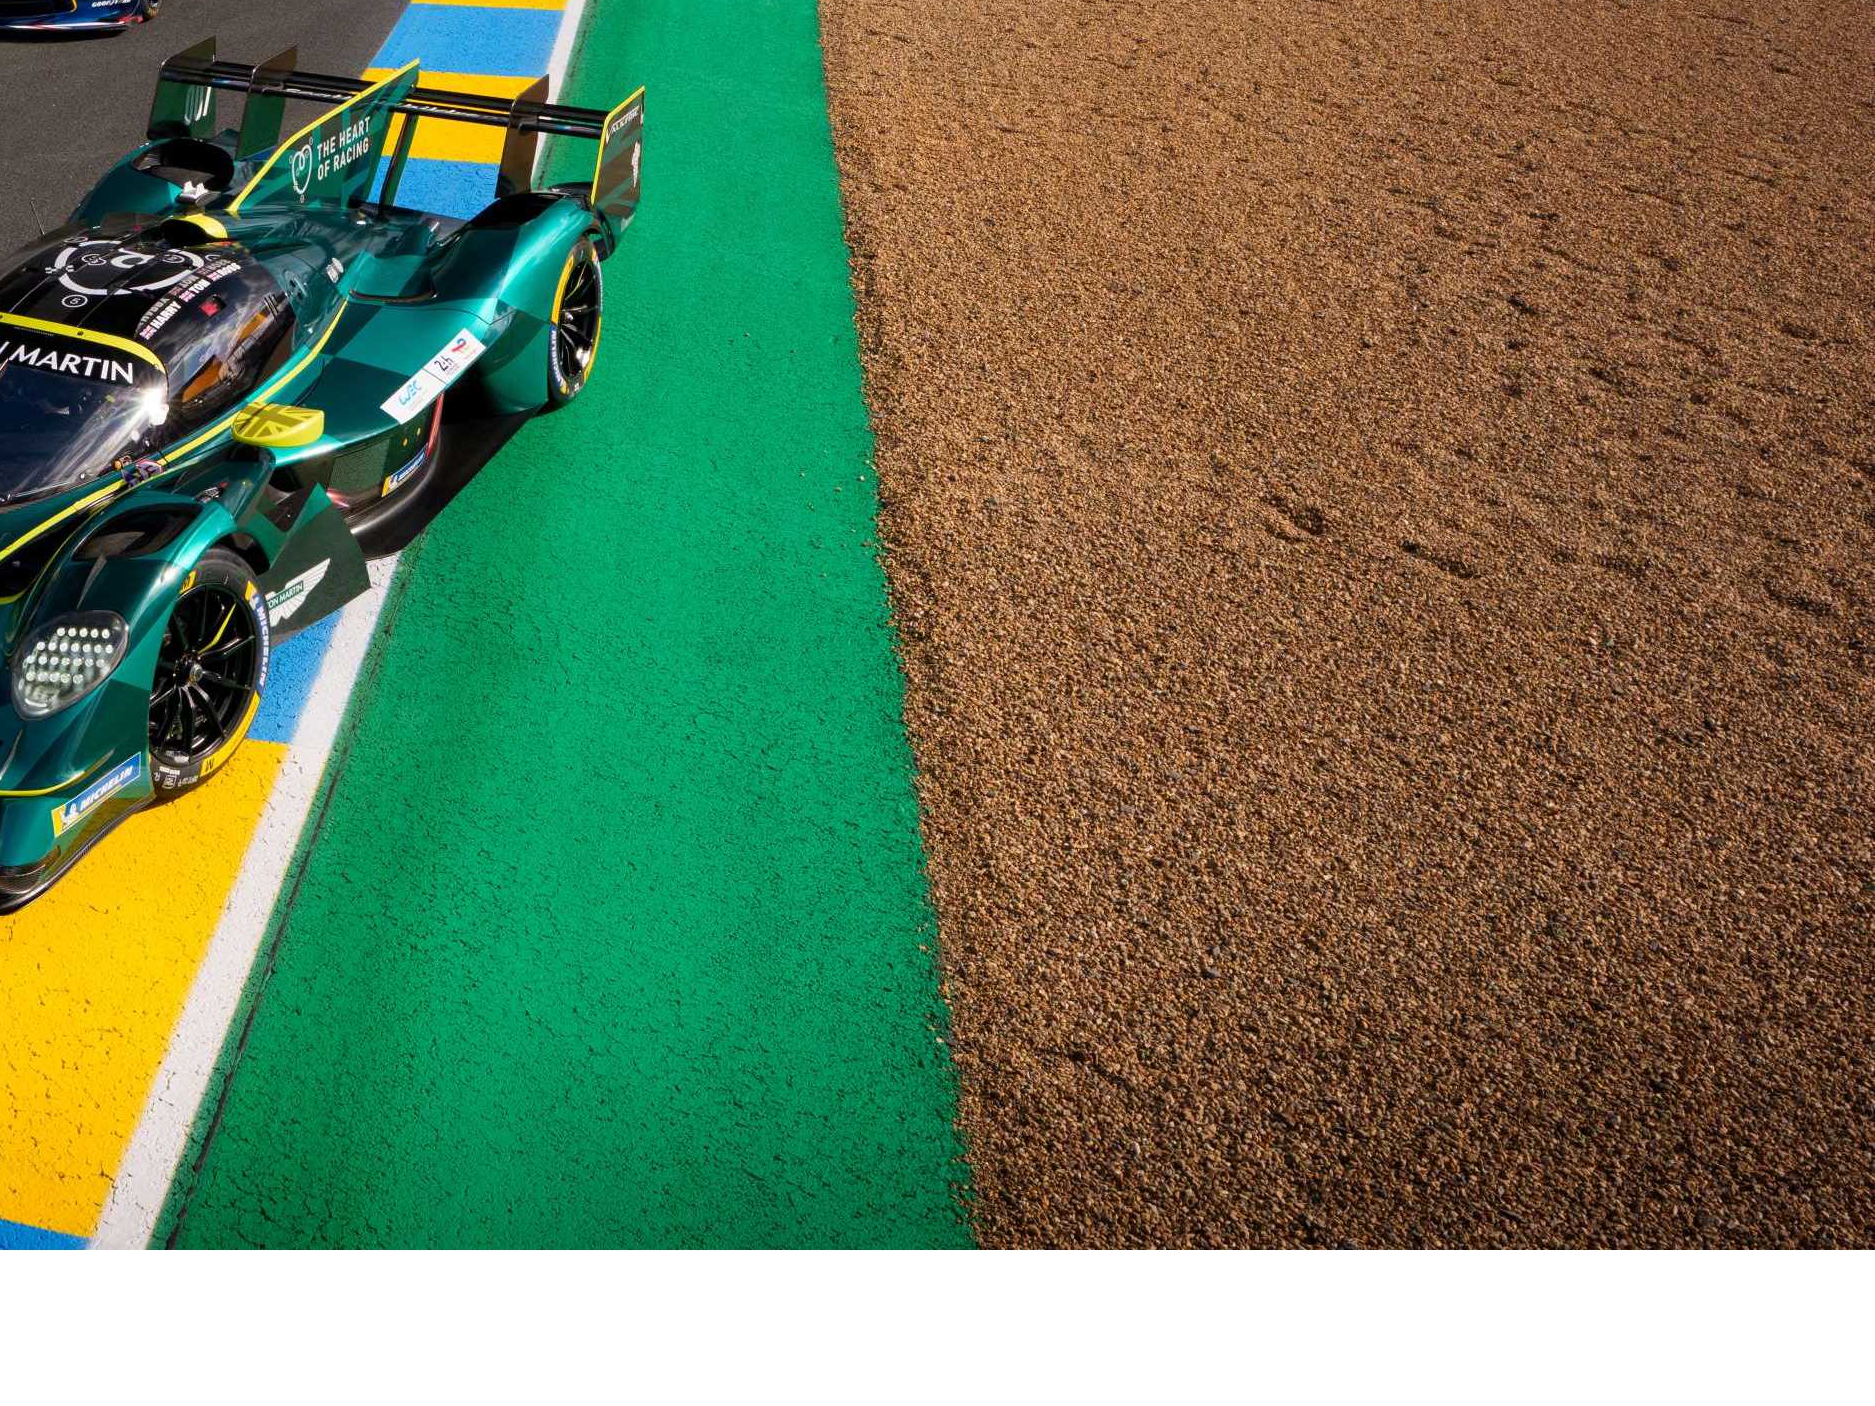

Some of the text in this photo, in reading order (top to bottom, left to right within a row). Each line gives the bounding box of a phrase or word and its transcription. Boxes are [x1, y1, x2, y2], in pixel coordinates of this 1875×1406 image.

[317, 116, 371, 160] THE HEART
[317, 139, 370, 181] OF RACING
[190, 278, 211, 293] TOM
[150, 301, 182, 329] HARRY
[8, 344, 134, 385] MARTIN
[279, 580, 303, 603] MARTIN
[80, 765, 134, 812] MICHELIN
